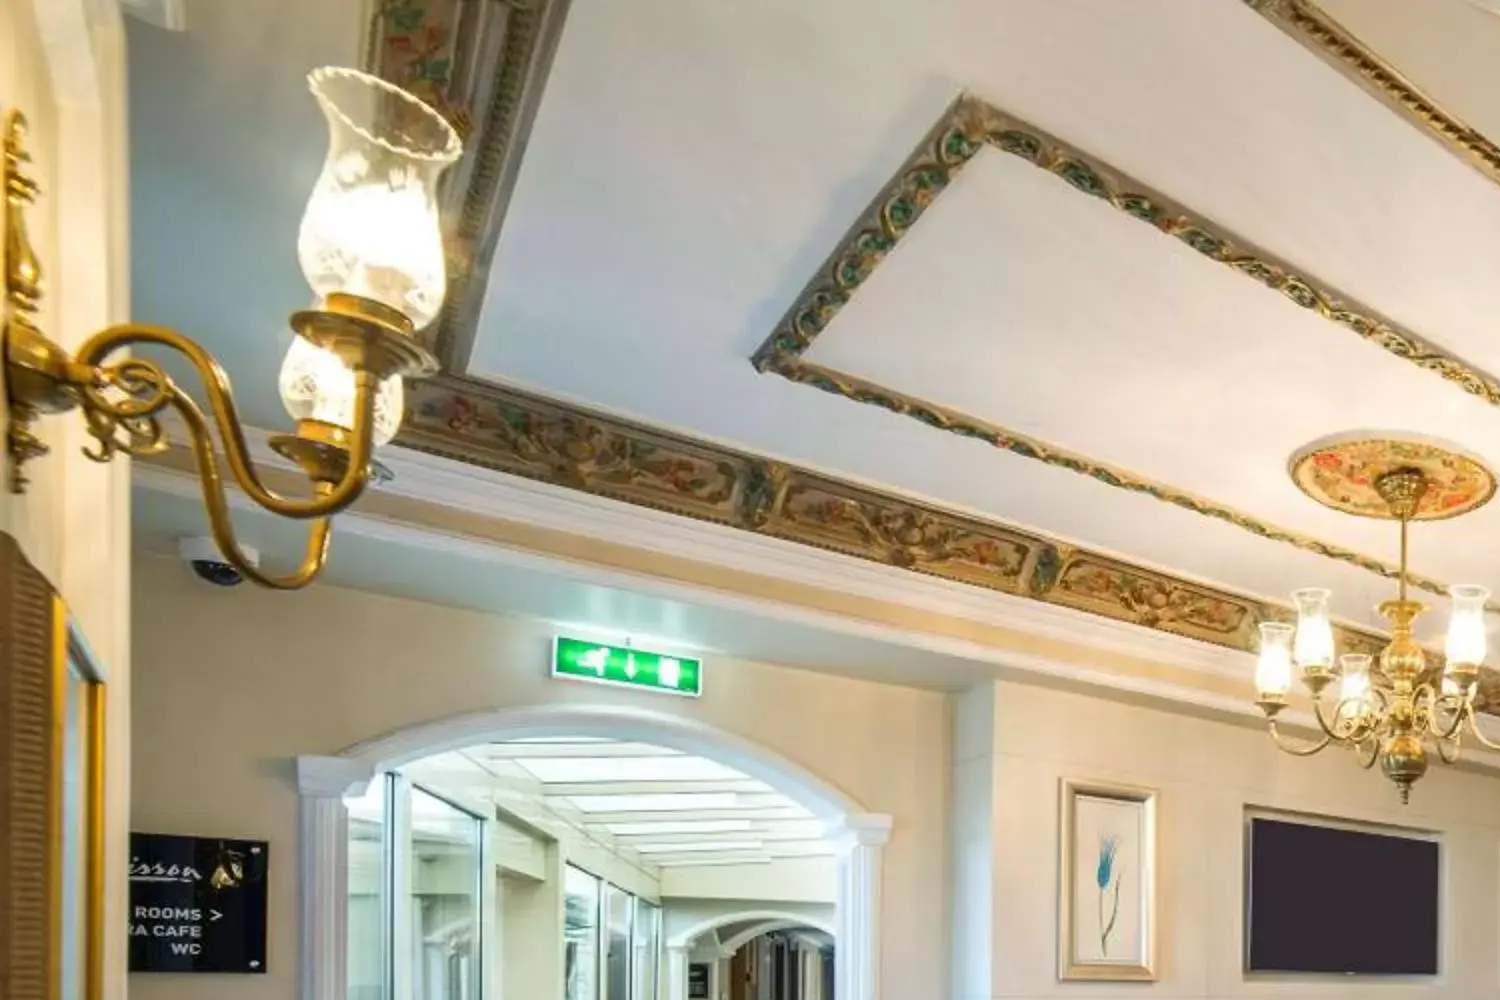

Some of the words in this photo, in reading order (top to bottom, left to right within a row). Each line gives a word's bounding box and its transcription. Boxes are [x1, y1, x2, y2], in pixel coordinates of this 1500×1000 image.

[135, 905, 202, 921] ROOMS
[153, 925, 202, 937] CAFE
[171, 943, 201, 955] WC
